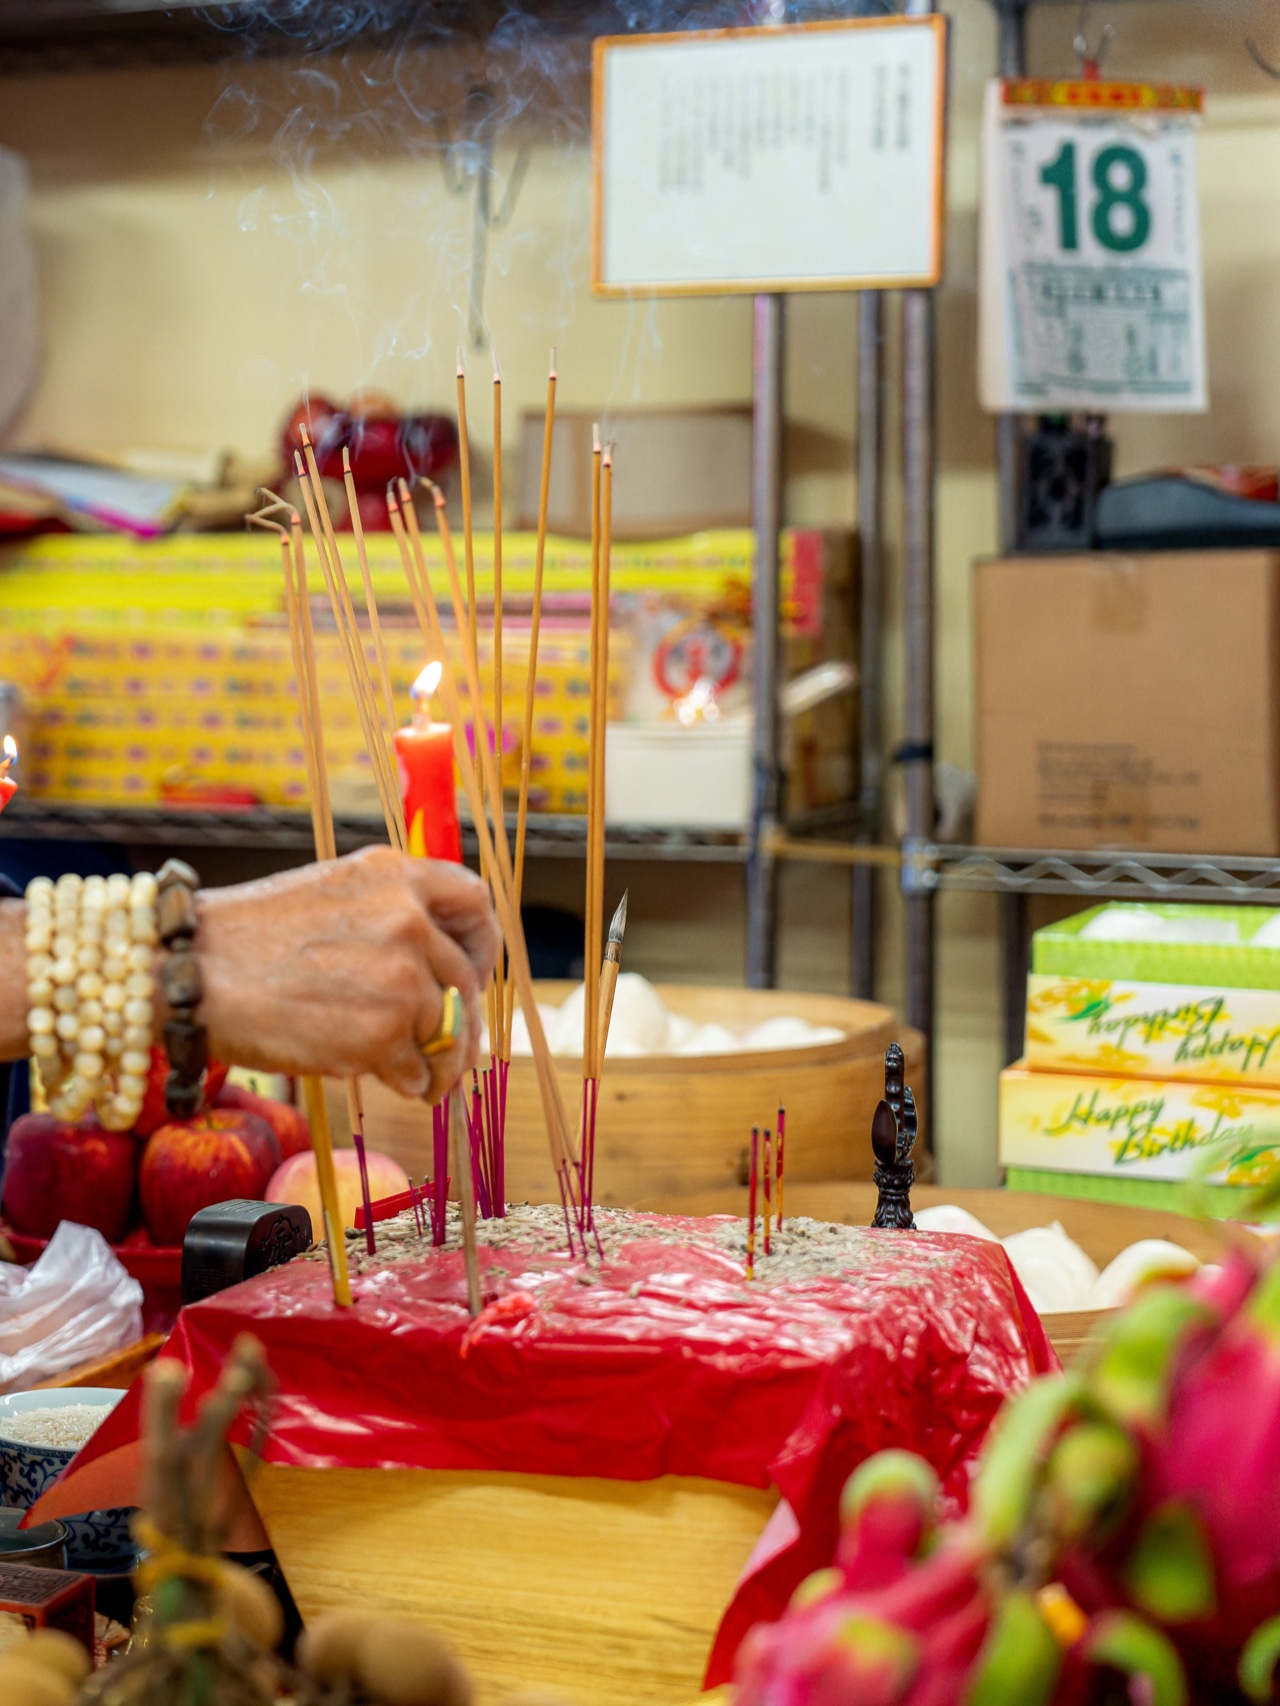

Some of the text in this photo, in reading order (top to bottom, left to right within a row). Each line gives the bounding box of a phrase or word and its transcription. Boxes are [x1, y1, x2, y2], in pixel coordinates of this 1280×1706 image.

[1040, 141, 1151, 252] 18
[1088, 997, 1225, 1050] Birthday
[1175, 1023, 1280, 1072] Happy
[1043, 1088, 1166, 1136] Happy
[1113, 1112, 1255, 1164] Birthday
